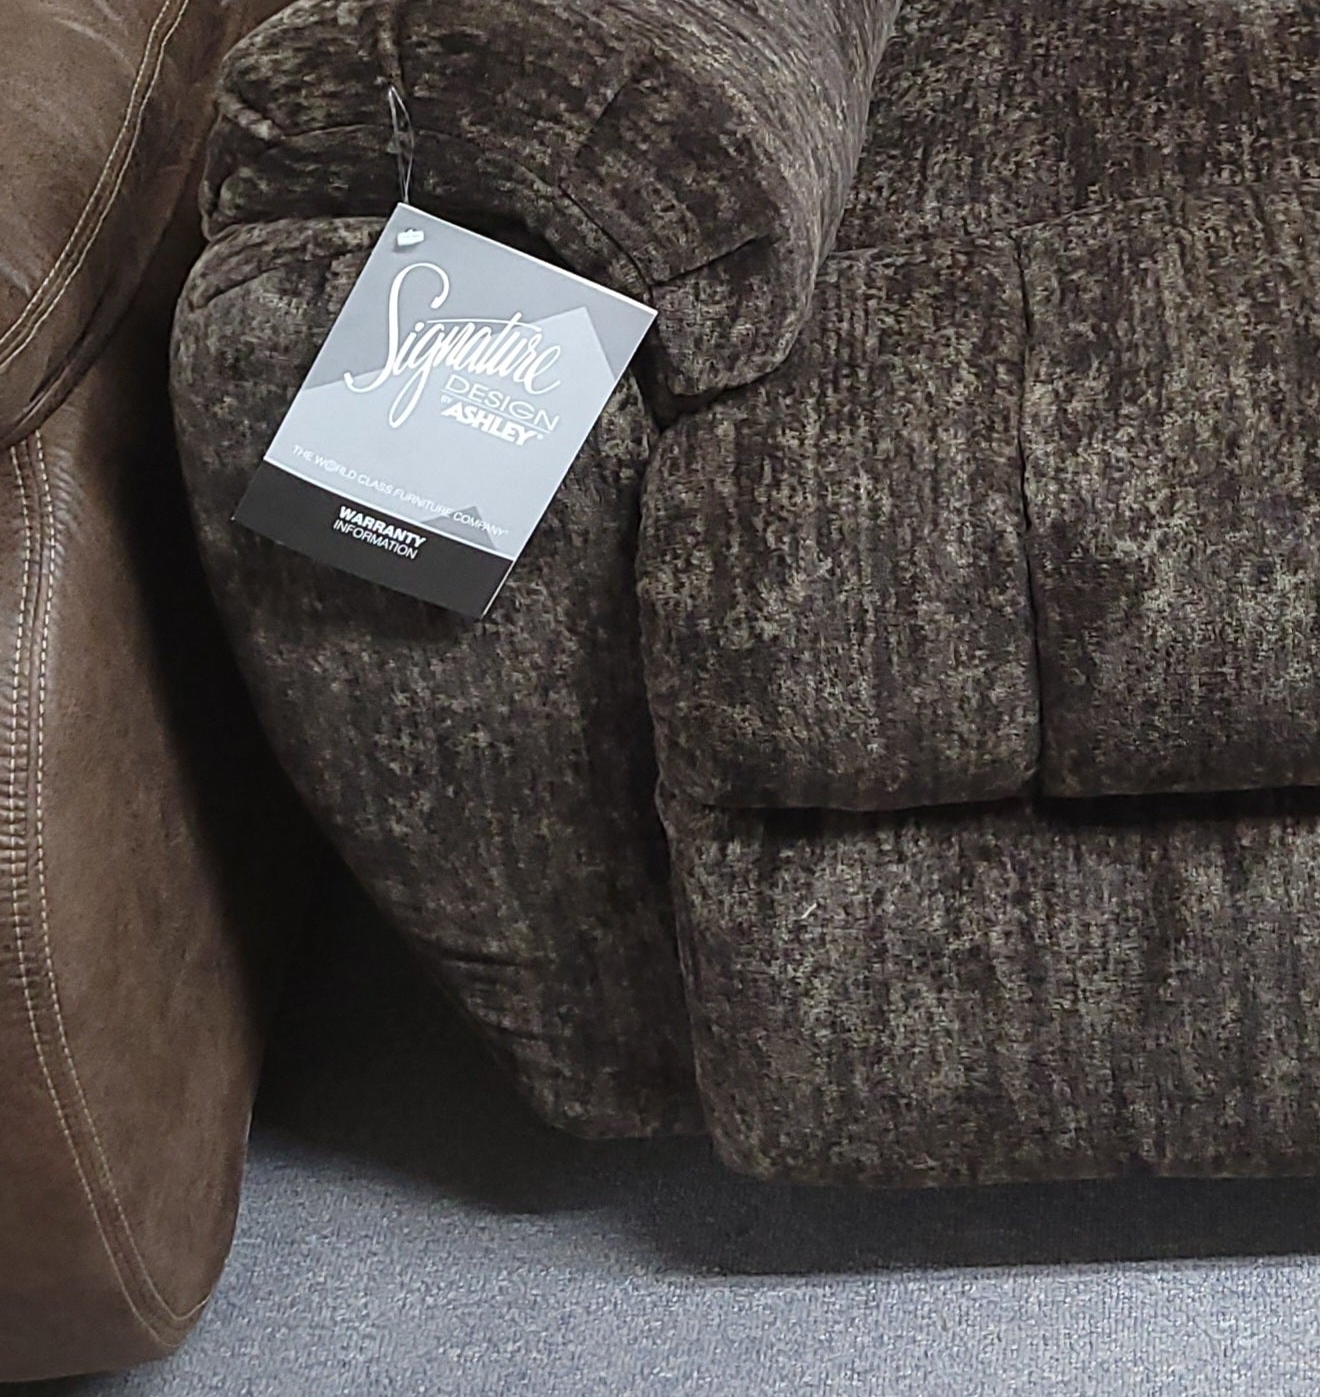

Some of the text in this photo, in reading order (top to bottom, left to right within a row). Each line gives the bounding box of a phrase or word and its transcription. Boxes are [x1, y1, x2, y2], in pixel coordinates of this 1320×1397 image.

[343, 262, 561, 429] Signature
[440, 394, 453, 404] BY
[445, 374, 560, 432] DESIGN
[441, 401, 538, 446] ASHLEY
[293, 445, 505, 537] THE WORLD CLASS FURNITURE COMPANY
[333, 519, 419, 560] INFORMATION
[339, 505, 427, 548] WARRANTY
